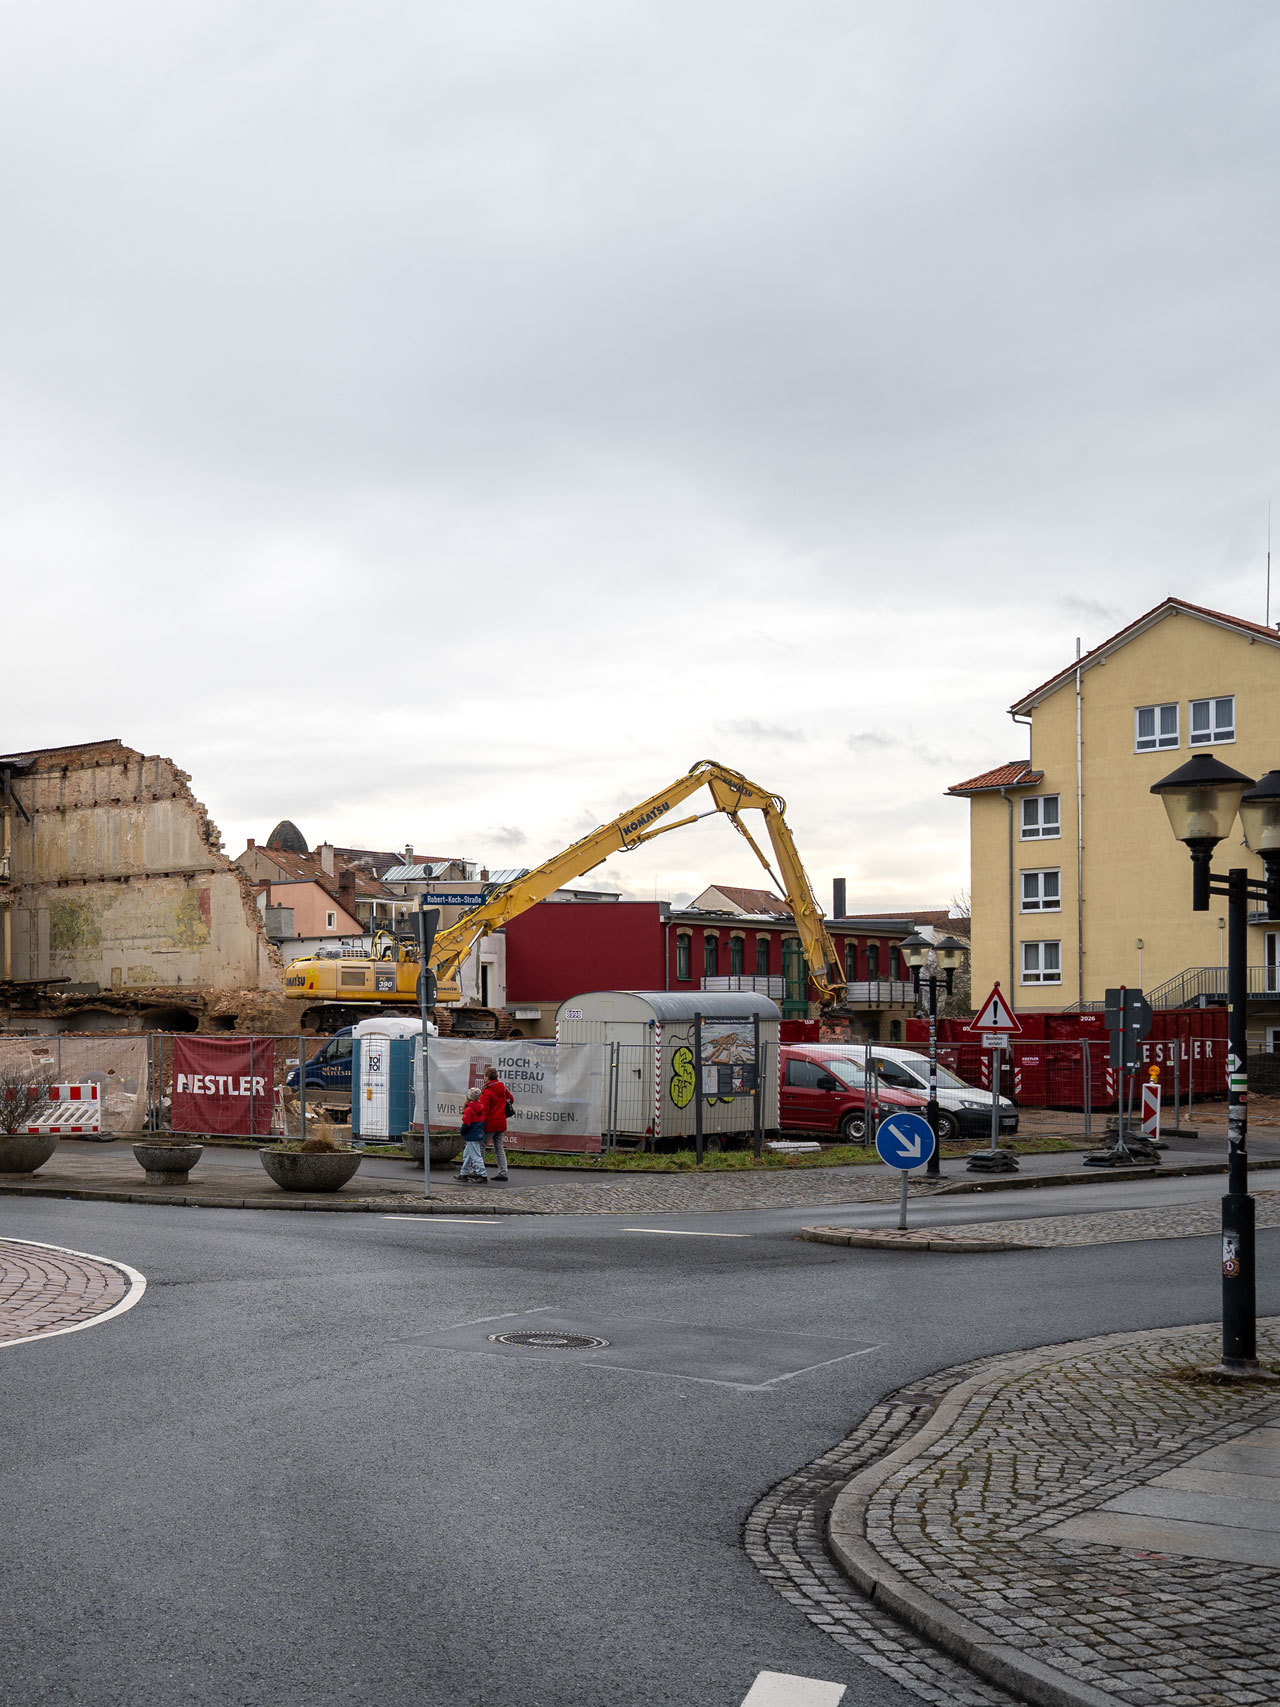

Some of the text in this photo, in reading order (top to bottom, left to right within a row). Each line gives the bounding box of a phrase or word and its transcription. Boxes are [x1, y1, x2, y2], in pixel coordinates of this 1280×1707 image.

[623, 801, 670, 836] KOMATSU
[427, 895, 482, 904] Robert-Koch-Straße
[1143, 1040, 1213, 1063] ESTLER
[369, 1054, 381, 1064] TOI
[498, 1057, 530, 1068] HOCH
[369, 1064, 381, 1072] TOI
[497, 1070, 544, 1082] TIEFBAU
[177, 1073, 265, 1096] NESTLER
[506, 1082, 543, 1095] RESDEN
[437, 1103, 456, 1114] WIR
[527, 1110, 578, 1123] DRESDEN.
